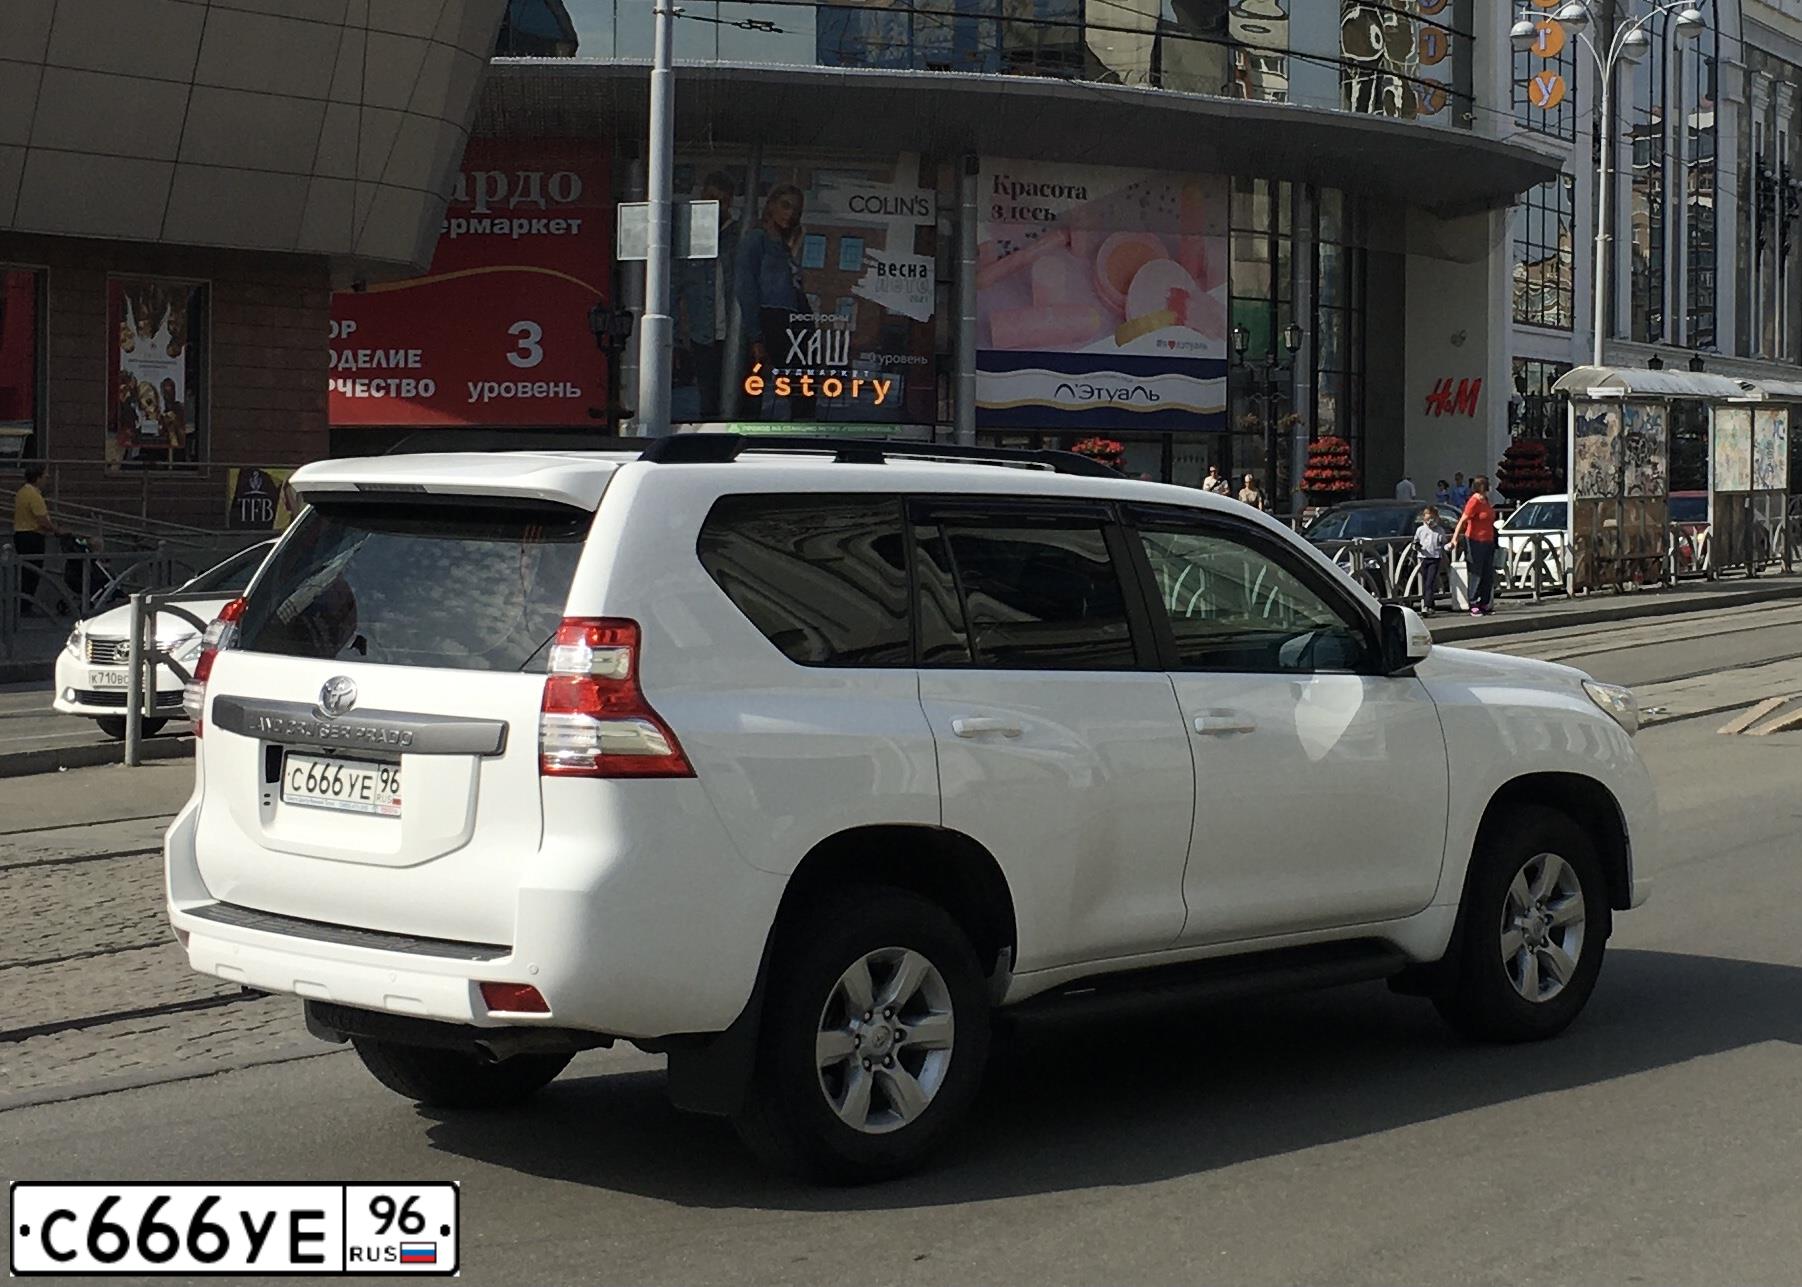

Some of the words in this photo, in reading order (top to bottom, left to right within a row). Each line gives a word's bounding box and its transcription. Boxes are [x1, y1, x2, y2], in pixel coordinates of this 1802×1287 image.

[992, 175, 1087, 201] Красота
[848, 195, 930, 217] COLIN'S
[506, 320, 544, 368] 3
[785, 328, 850, 366] ХАШ
[879, 354, 929, 366] уровень
[467, 381, 582, 403] уровень
[744, 363, 892, 406] éstory
[1425, 377, 1482, 417] H&M
[238, 498, 273, 522] TFB
[291, 761, 373, 801] С666УЕ
[380, 768, 400, 795] 96
